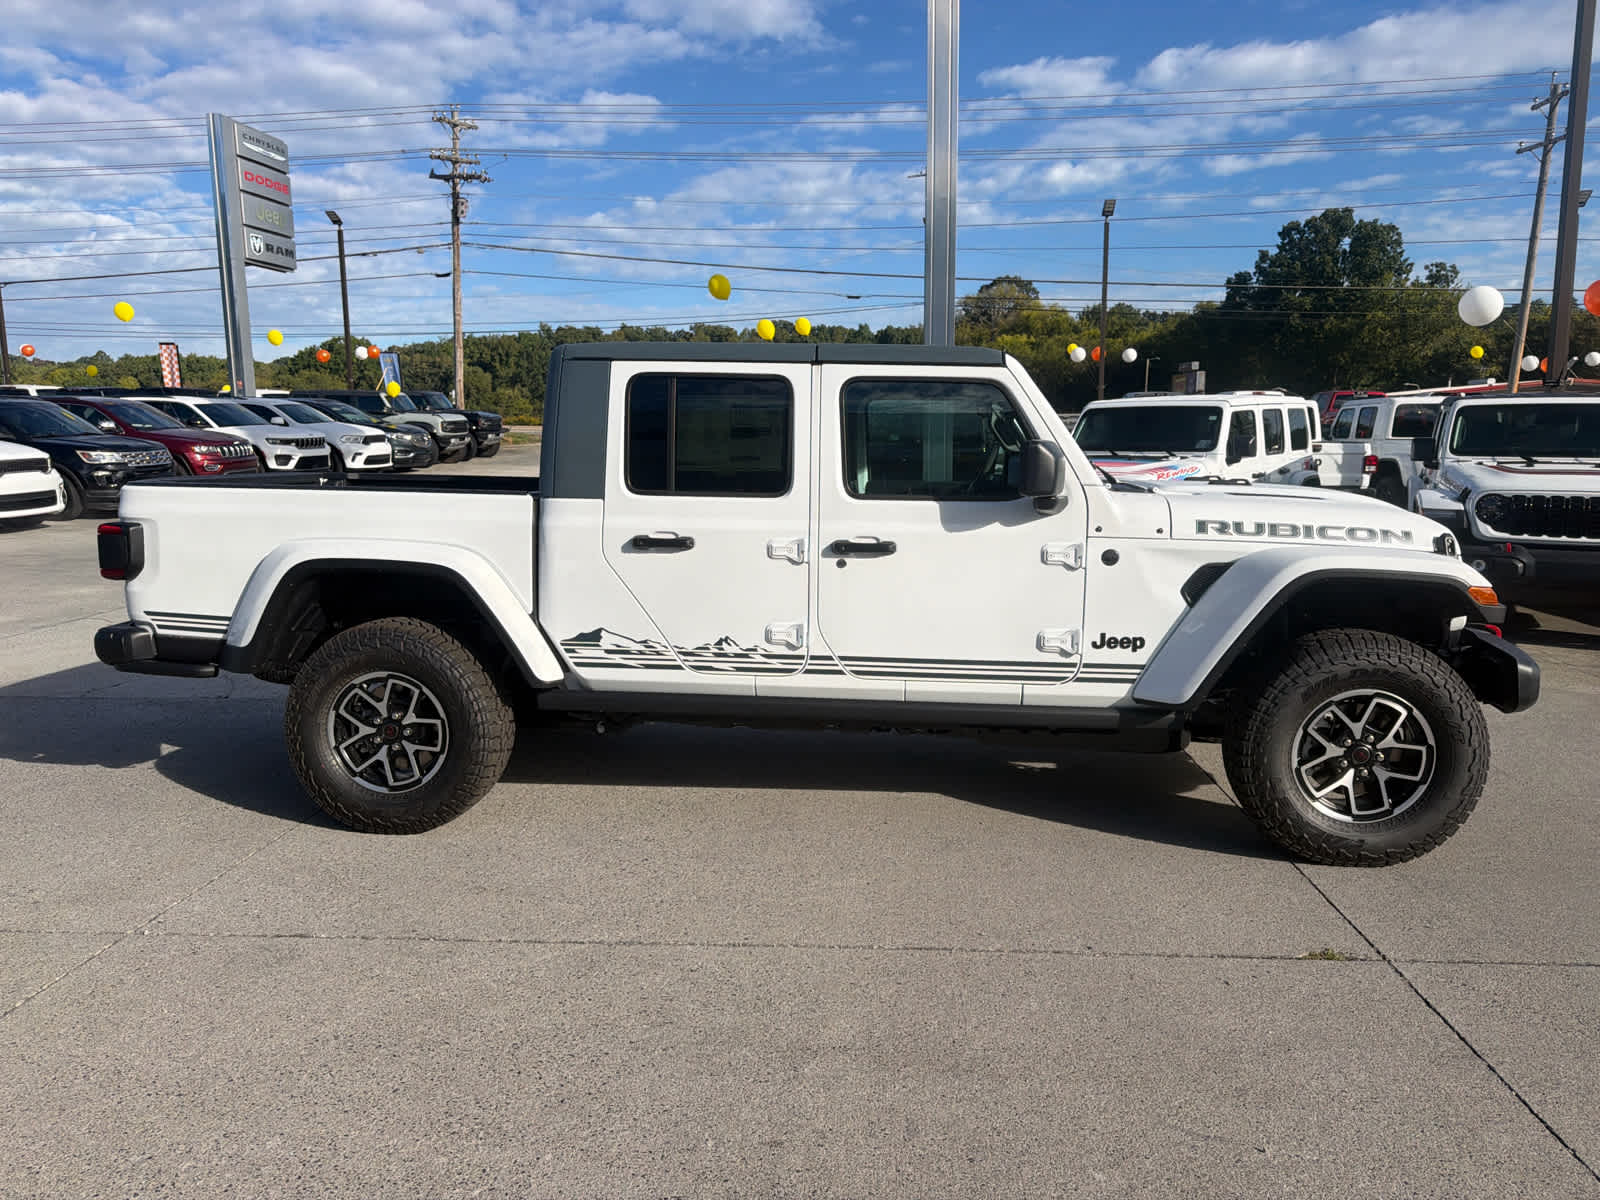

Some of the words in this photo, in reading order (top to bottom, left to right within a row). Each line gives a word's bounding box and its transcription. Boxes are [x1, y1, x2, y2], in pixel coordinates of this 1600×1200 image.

[242, 133, 286, 154] CHRYSLER
[244, 171, 289, 194] DODGE
[265, 243, 295, 259] RAM
[1195, 519, 1413, 544] RUBICON
[1091, 632, 1146, 653] Jeep
